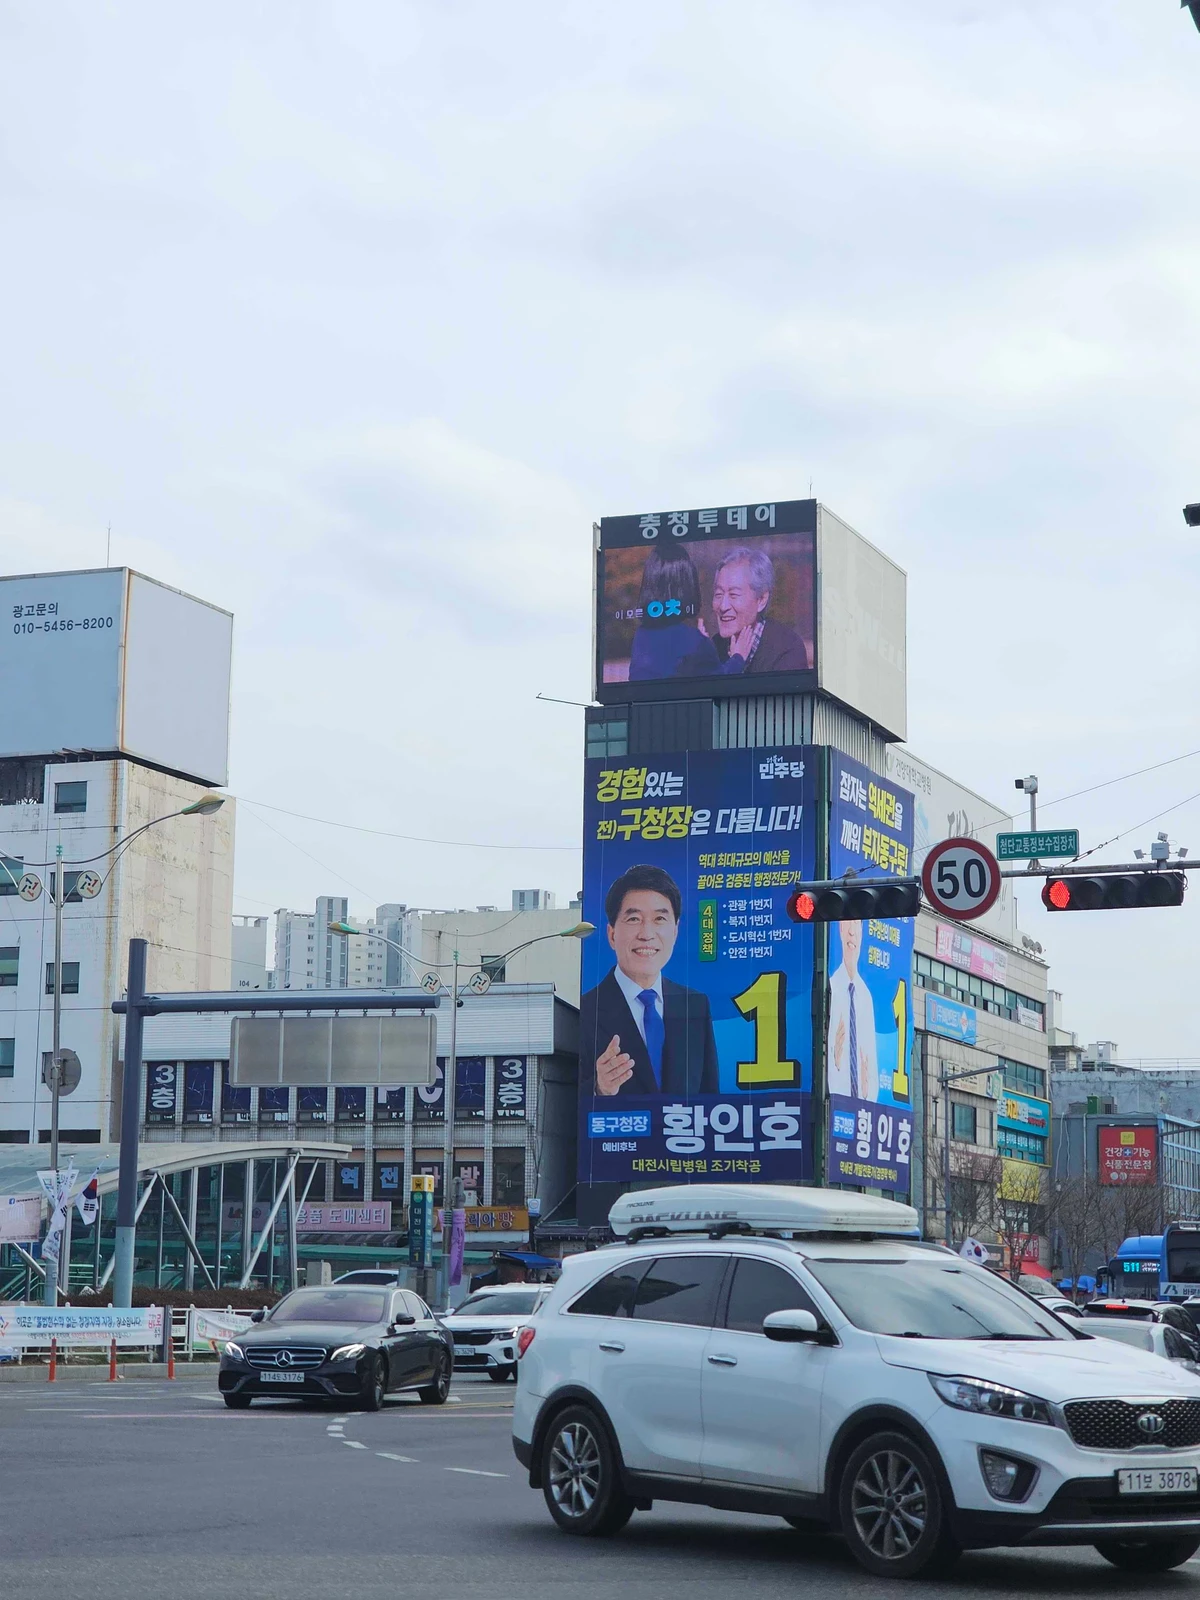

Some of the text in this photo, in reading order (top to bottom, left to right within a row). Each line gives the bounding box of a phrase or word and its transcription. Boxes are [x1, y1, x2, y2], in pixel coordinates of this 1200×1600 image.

[638, 503, 777, 540] 충청투데이
[12, 602, 60, 619] 광고문의
[615, 609, 625, 620] 이
[625, 608, 645, 620] 모든
[685, 603, 695, 615] 이
[12, 616, 114, 635] 010-5456-8200
[759, 761, 806, 780] 민주당
[895, 757, 933, 797] 건양대학교병원
[596, 767, 685, 803] 경험있는
[840, 769, 904, 832] 잠자는 역세권을
[596, 805, 804, 841] 전)구청장은 다릅니다!
[840, 818, 862, 854] 깨워
[999, 834, 1077, 855] 첨단교통정보수집장치
[698, 849, 791, 868] 역대 최대규모의 예산을
[697, 873, 725, 890] 끌어온
[725, 872, 753, 889] 검증된
[937, 858, 987, 900] 50
[728, 898, 773, 912] 관광 1번지
[728, 914, 773, 928] 복지 1번지
[728, 929, 792, 943] 도시혁신 1번지
[728, 945, 773, 959] 안전 1번지
[239, 979, 250, 988] 104
[733, 972, 796, 1085] 1
[892, 979, 908, 1097] 1
[151, 1064, 175, 1109] 3층
[498, 1058, 524, 1105] 3층
[591, 1115, 649, 1133] 동구청장
[662, 1101, 803, 1154] 황인호
[833, 1115, 855, 1135] 동구청장
[855, 1107, 912, 1164] 황인호
[602, 1141, 638, 1152] 예비후보
[1105, 1147, 1151, 1157] 건강 기능
[632, 1158, 762, 1174] 대전시립병원 조기착공
[1105, 1159, 1152, 1170] 식품전문점
[329, 1208, 386, 1225] 도매센터
[497, 1211, 515, 1229] 빵
[1123, 1262, 1140, 1273] 511
[16, 1316, 33, 1328] 이곳은
[1127, 1471, 1192, 1490] 11보 3878
